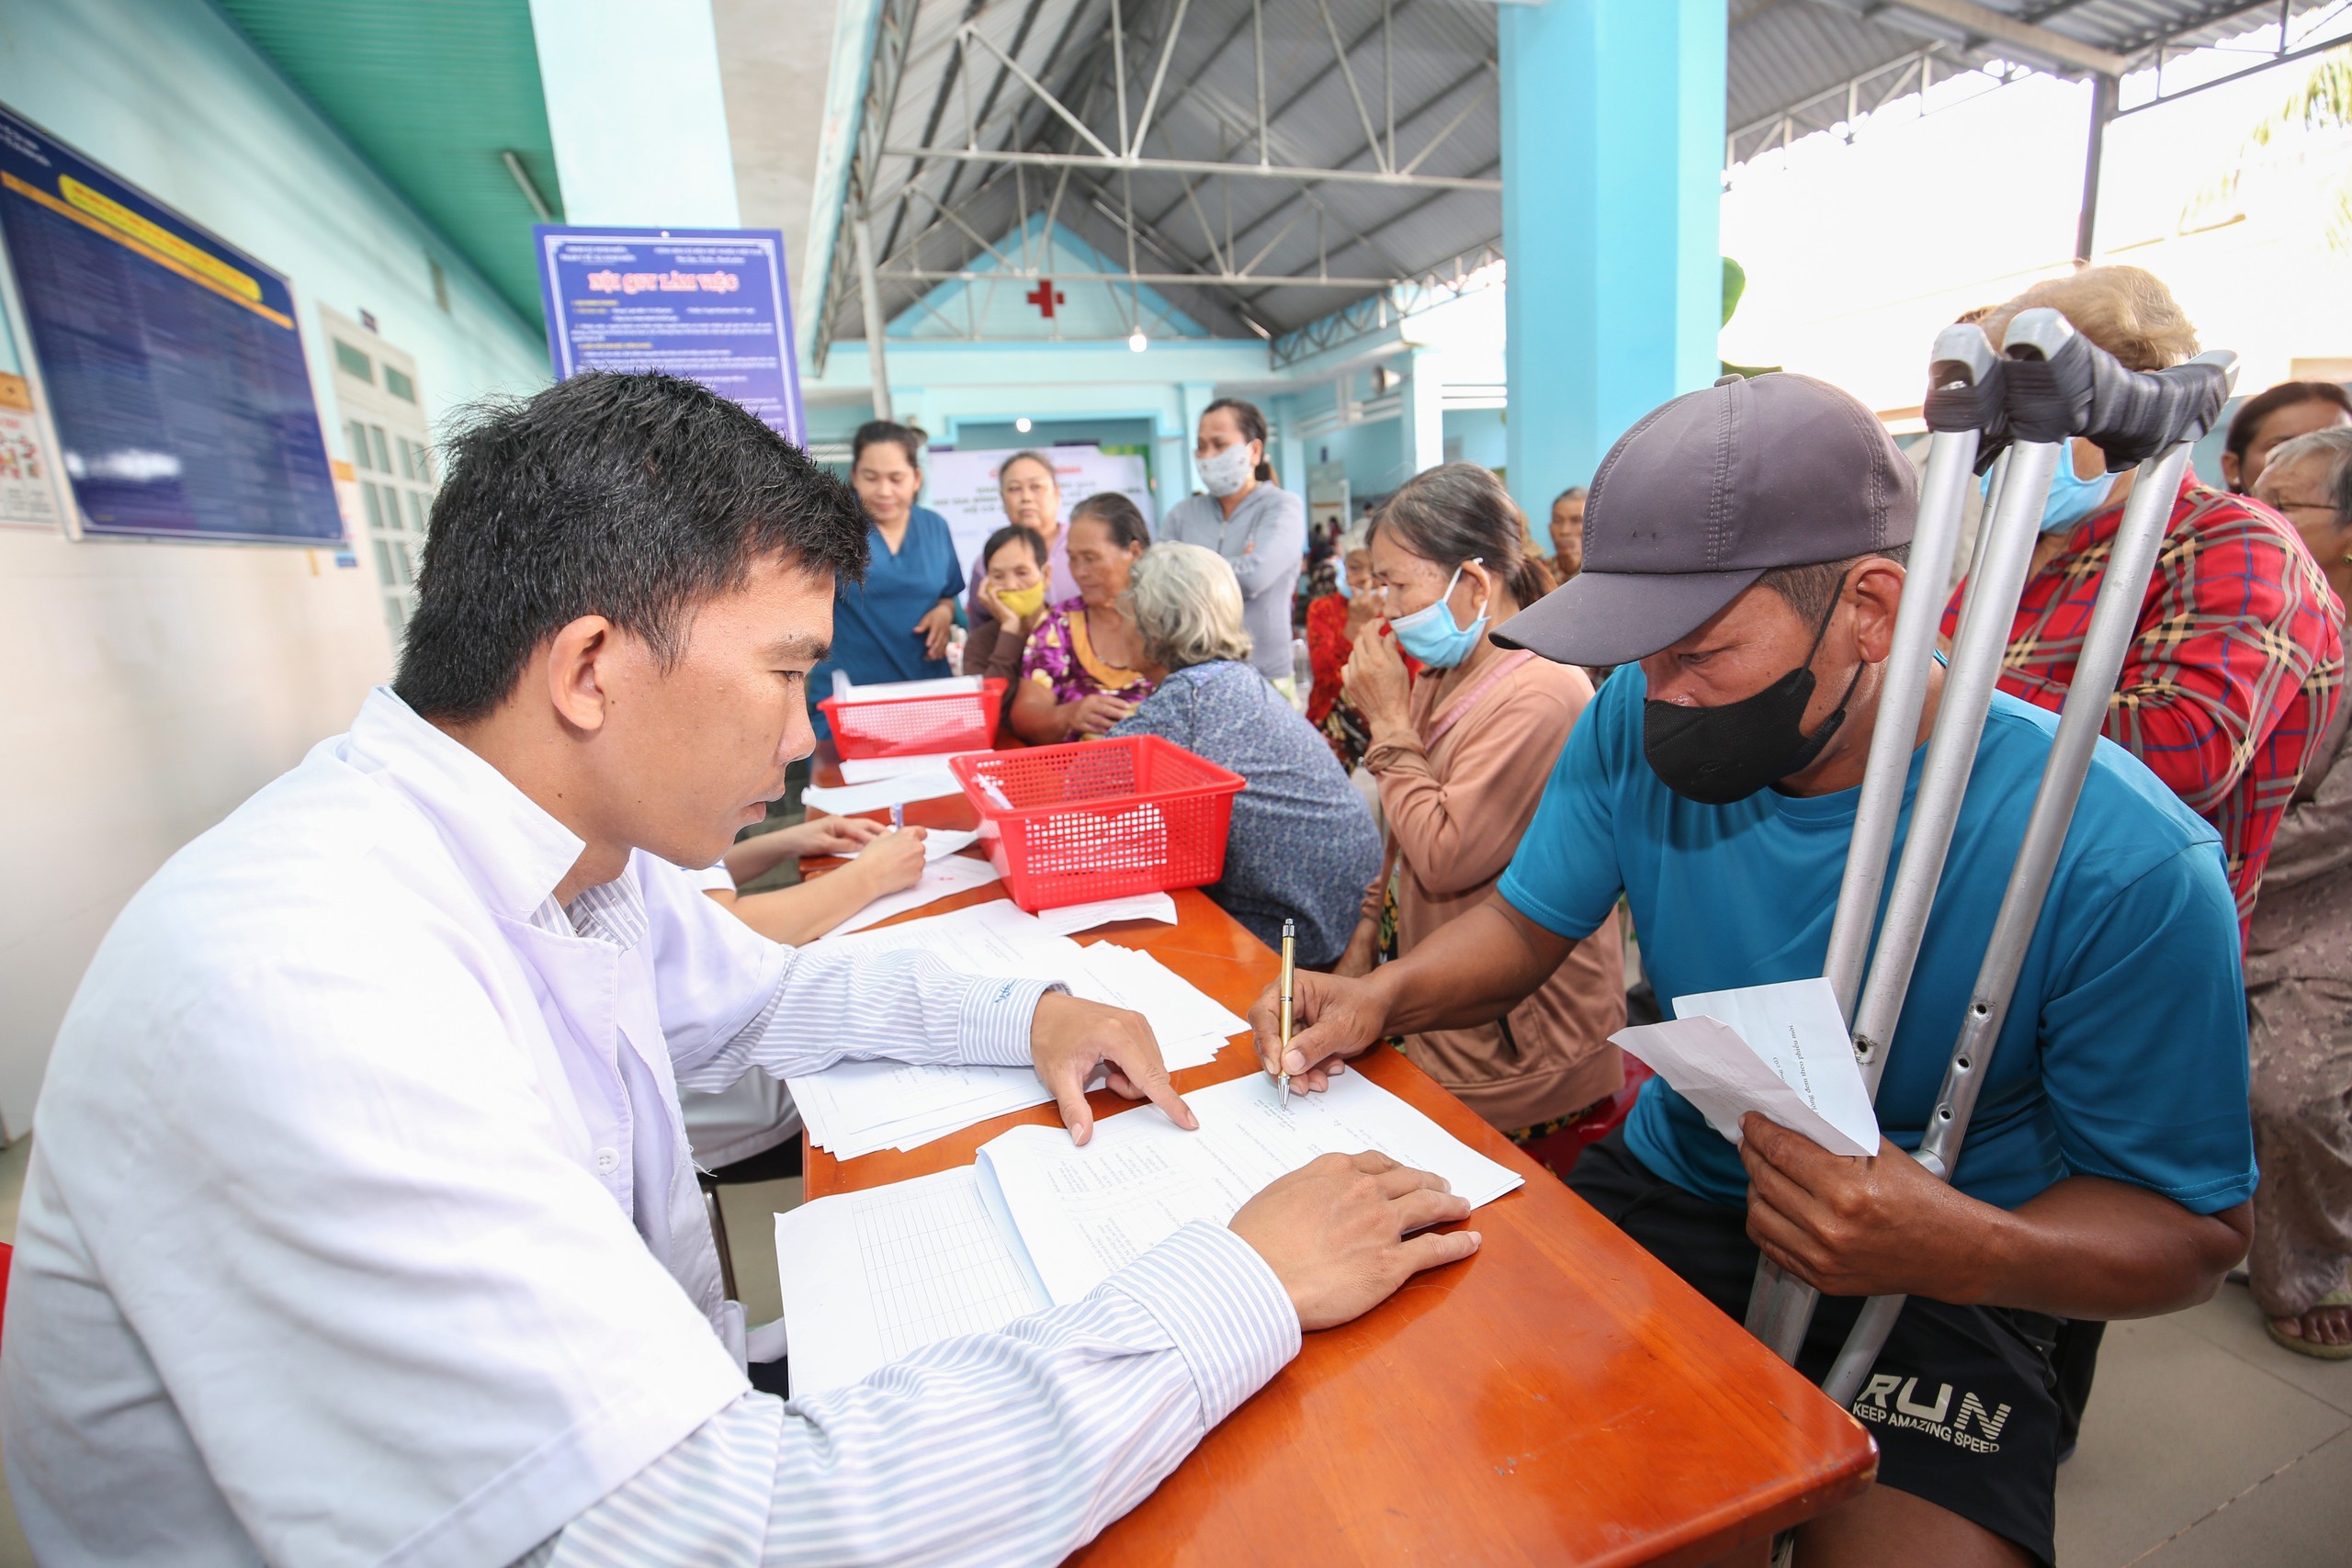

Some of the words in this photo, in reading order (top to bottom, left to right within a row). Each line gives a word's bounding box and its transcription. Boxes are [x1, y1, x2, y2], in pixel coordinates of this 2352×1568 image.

[1852, 1403, 1886, 1423] KEEP
[1888, 1412, 1951, 1442] AMAZING
[1953, 1431, 2000, 1453] SPEED
[1856, 1373, 2012, 1440] RUN
